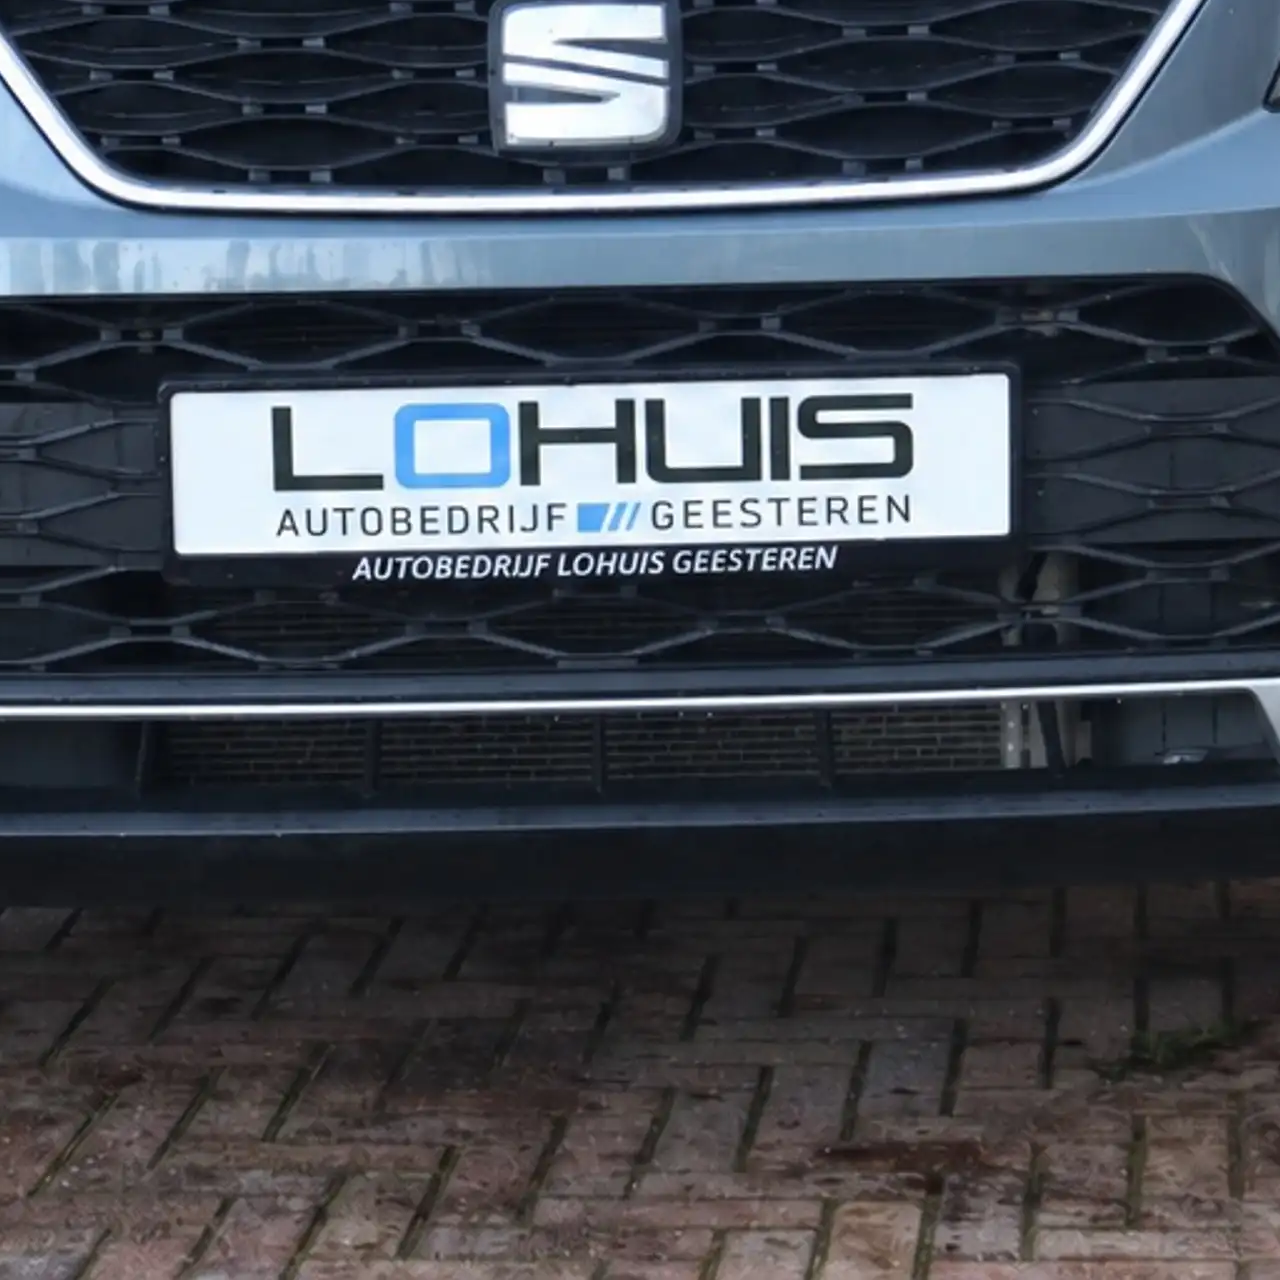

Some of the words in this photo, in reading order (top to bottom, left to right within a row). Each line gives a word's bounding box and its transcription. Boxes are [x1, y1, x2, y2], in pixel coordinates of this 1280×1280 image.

[271, 392, 915, 493] LOHUIS
[275, 501, 569, 538] AUTOBEDRIJF
[650, 493, 913, 531] GEESTEREN
[351, 551, 552, 582] AUTOBEDRIJF
[557, 548, 669, 578] LOHUIS
[671, 545, 839, 575] GEESTEREN
